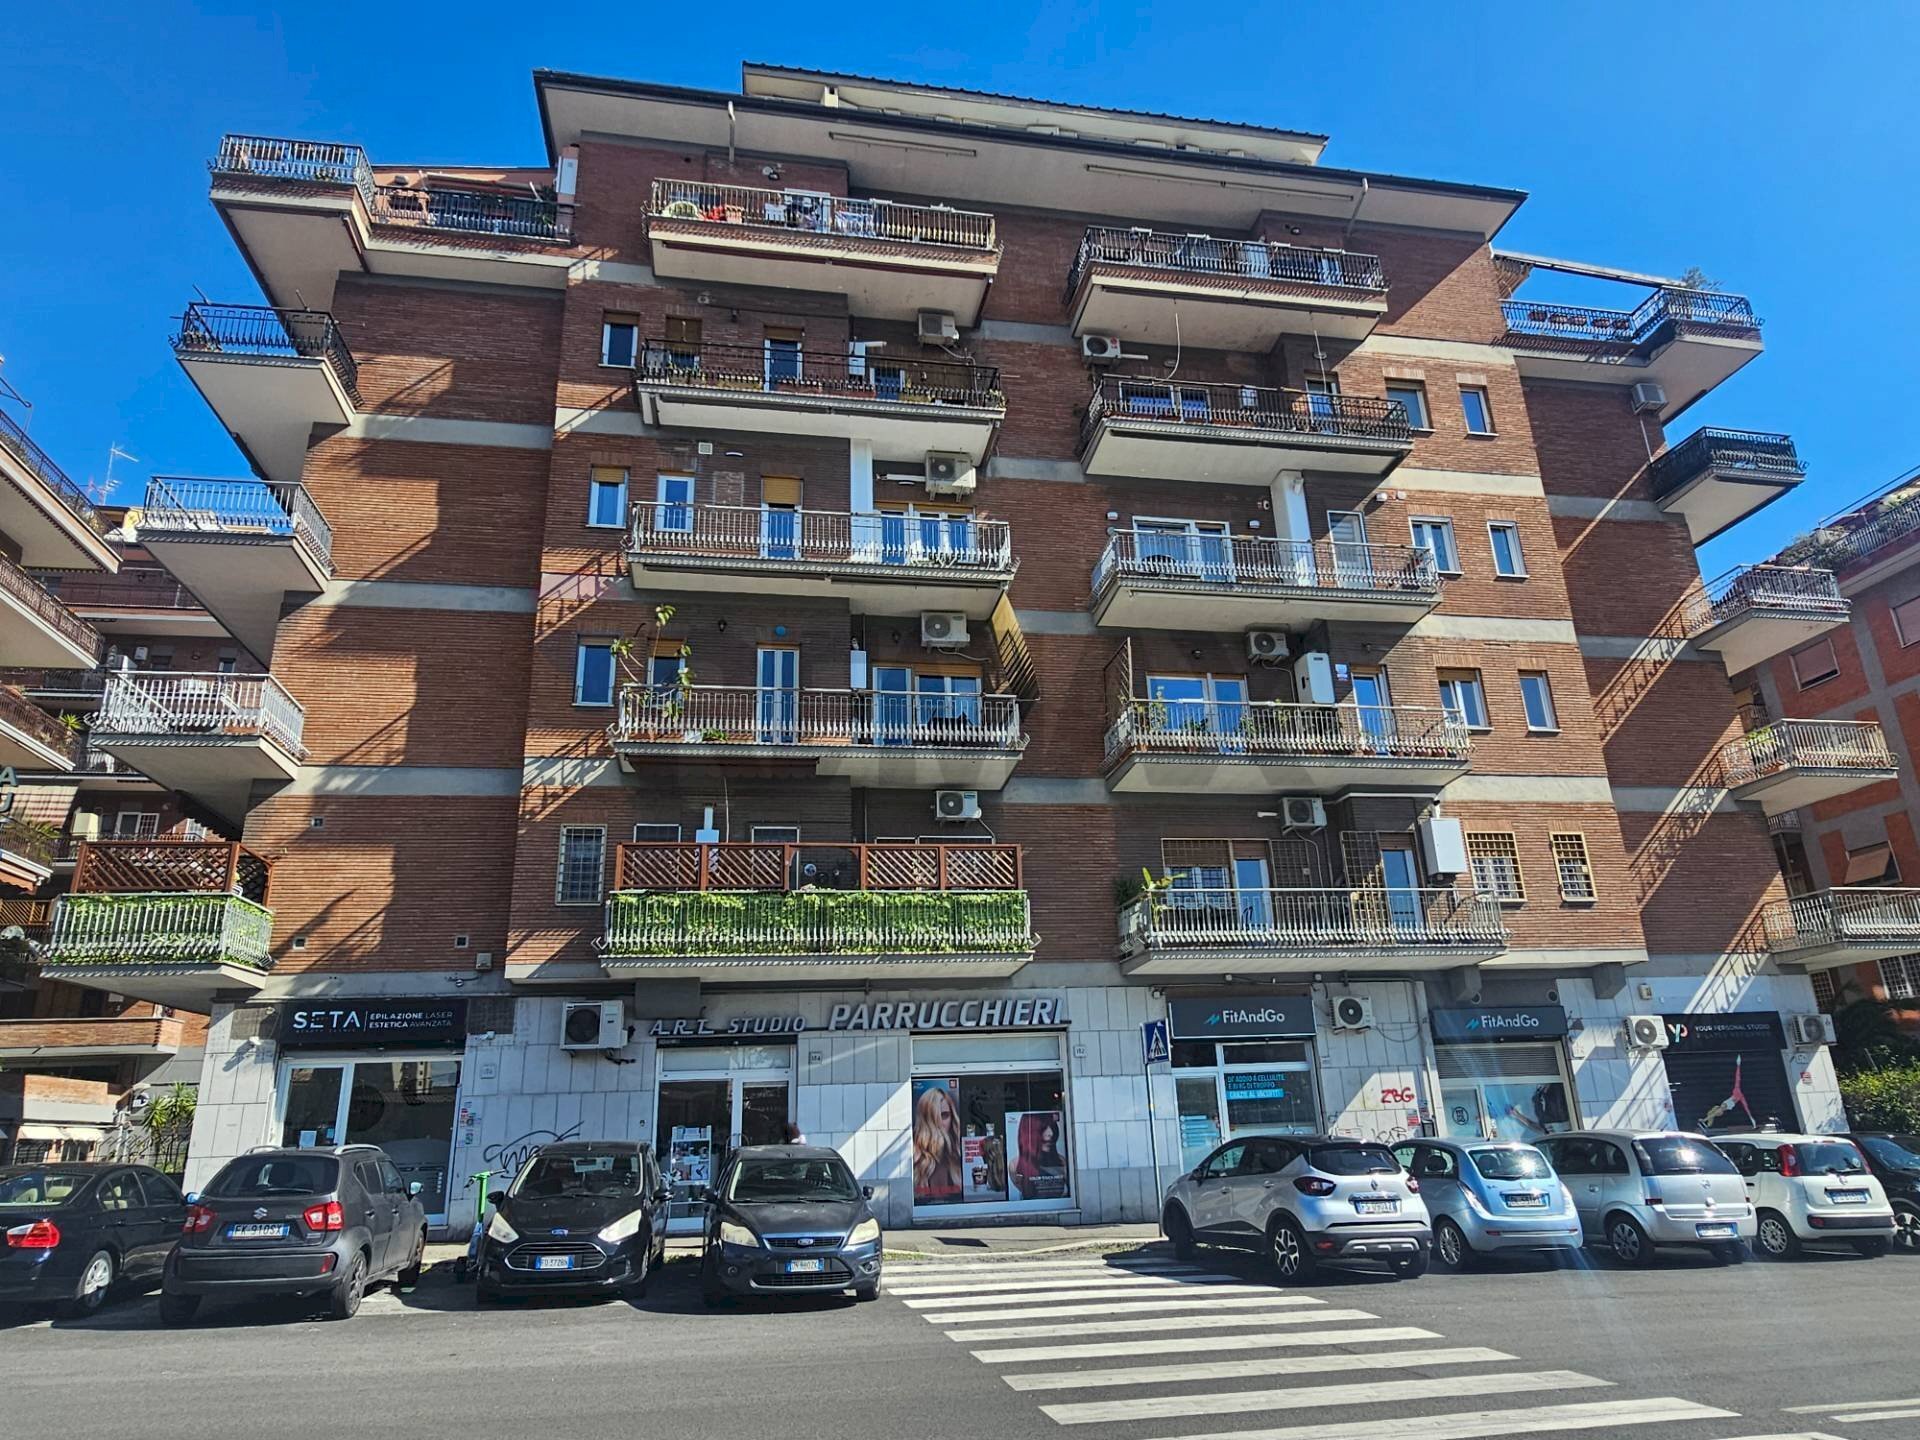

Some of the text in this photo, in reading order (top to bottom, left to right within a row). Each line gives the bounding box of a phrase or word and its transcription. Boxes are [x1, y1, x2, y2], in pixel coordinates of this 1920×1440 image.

[293, 1010, 361, 1029] SETA
[369, 1011, 453, 1020] EPILAZIONE LASER
[828, 999, 1067, 1031] PARRUCCHIERI
[1222, 1008, 1285, 1024] FitAndGo
[1480, 1013, 1539, 1028] FitAndGo
[369, 1019, 452, 1029] ESTETICA AVANZATA
[727, 1016, 807, 1034] STUDIO
